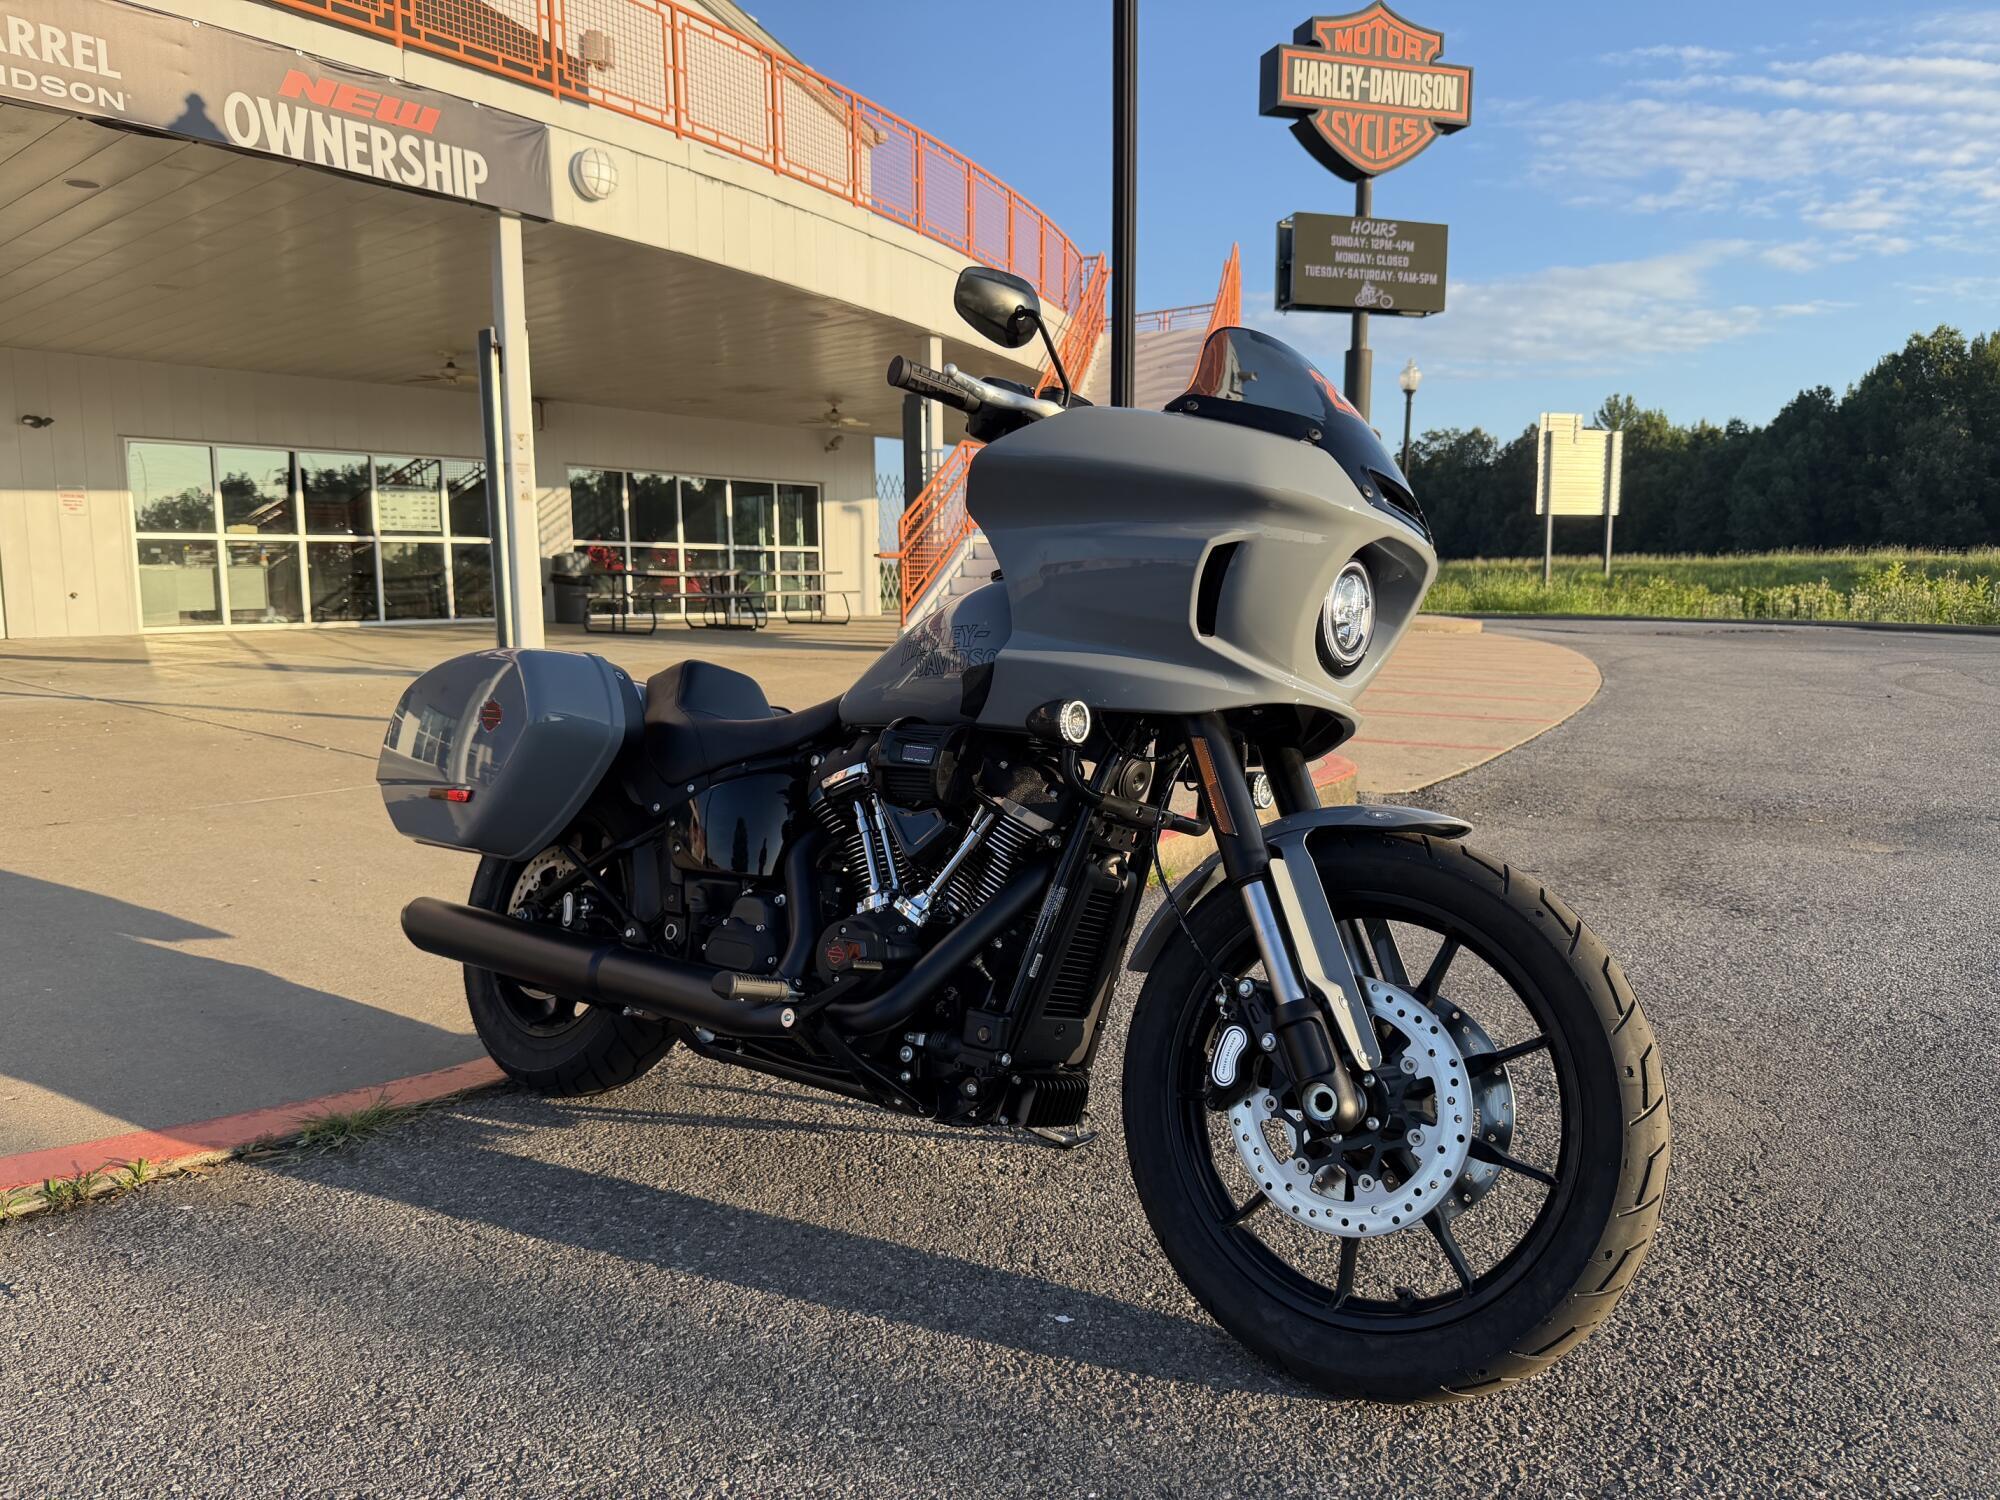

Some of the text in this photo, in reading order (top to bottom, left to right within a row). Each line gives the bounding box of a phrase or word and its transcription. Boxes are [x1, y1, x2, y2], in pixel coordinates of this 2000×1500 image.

[1334, 17, 1423, 62] MOTOR
[278, 68, 441, 135] NEW
[1293, 58, 1458, 111] HARLEY-DAVIDSON
[223, 91, 489, 201] OWNERSHIP
[1331, 110, 1421, 160] CYCLES
[1330, 235, 1415, 253] SUNDAY: 12PM-4PM
[1350, 220, 1398, 239] HOURS
[1304, 265, 1438, 285] TUESDAY-SATURDAY: 9AM-5PM
[1335, 251, 1409, 268] MONDAY: CLOSED
[914, 648, 998, 677] DAVIDSO
